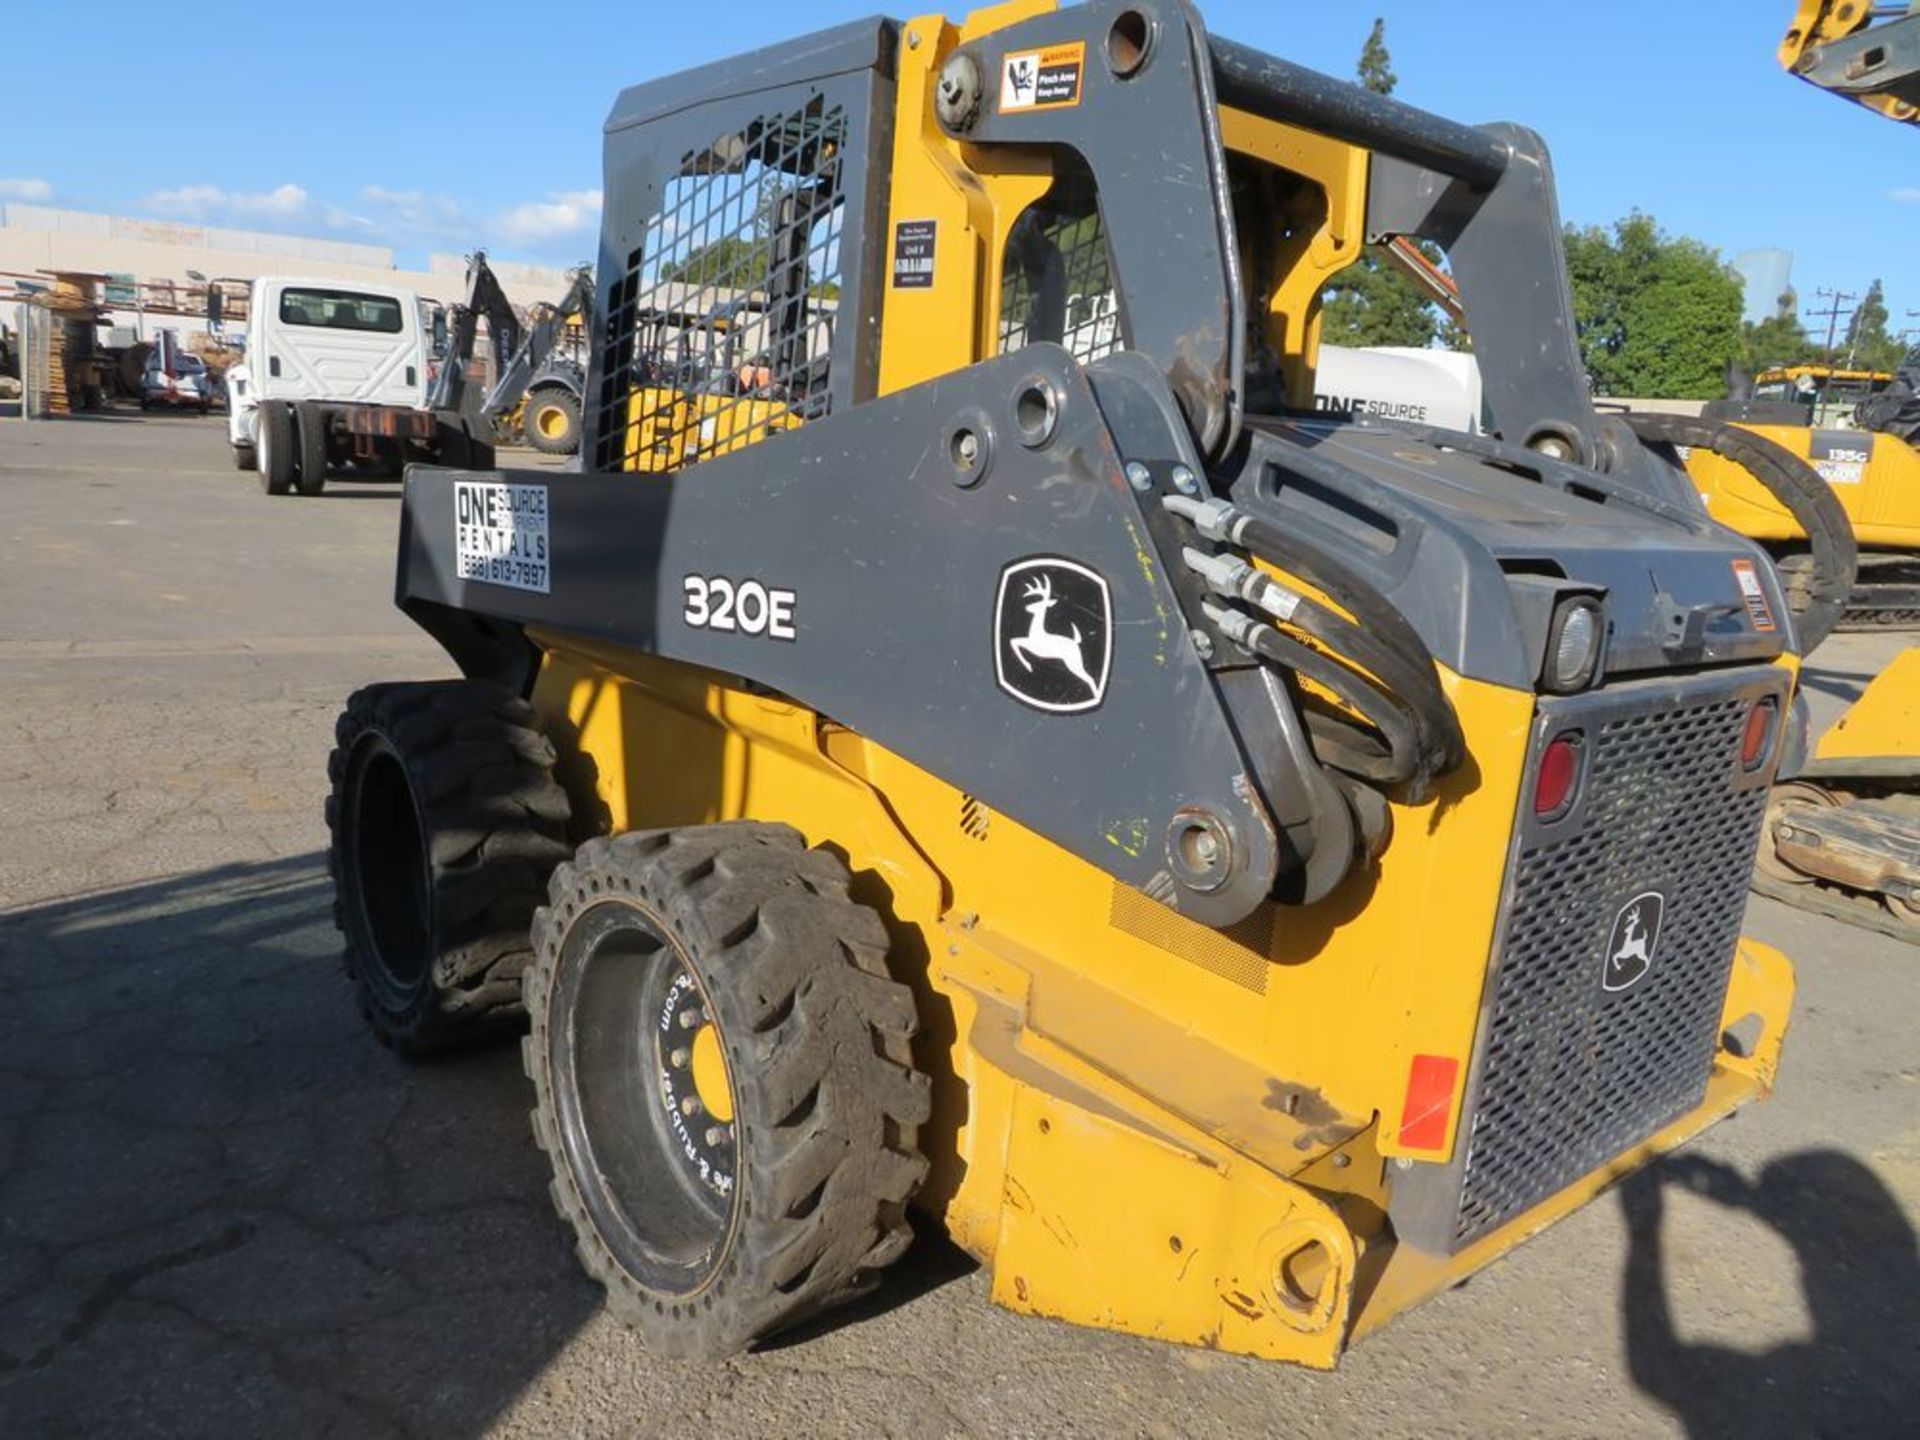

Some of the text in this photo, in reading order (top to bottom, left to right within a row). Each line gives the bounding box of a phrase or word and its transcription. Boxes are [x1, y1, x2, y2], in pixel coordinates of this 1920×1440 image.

[1039, 73, 1059, 85] Pinch
[1368, 400, 1427, 421] SOURCE
[1829, 449, 1868, 462] 135G
[458, 486, 545, 528] ONE SOURCE
[460, 526, 545, 560] RENTALS
[491, 558, 546, 587] 613-7997
[684, 575, 796, 640] 320E
